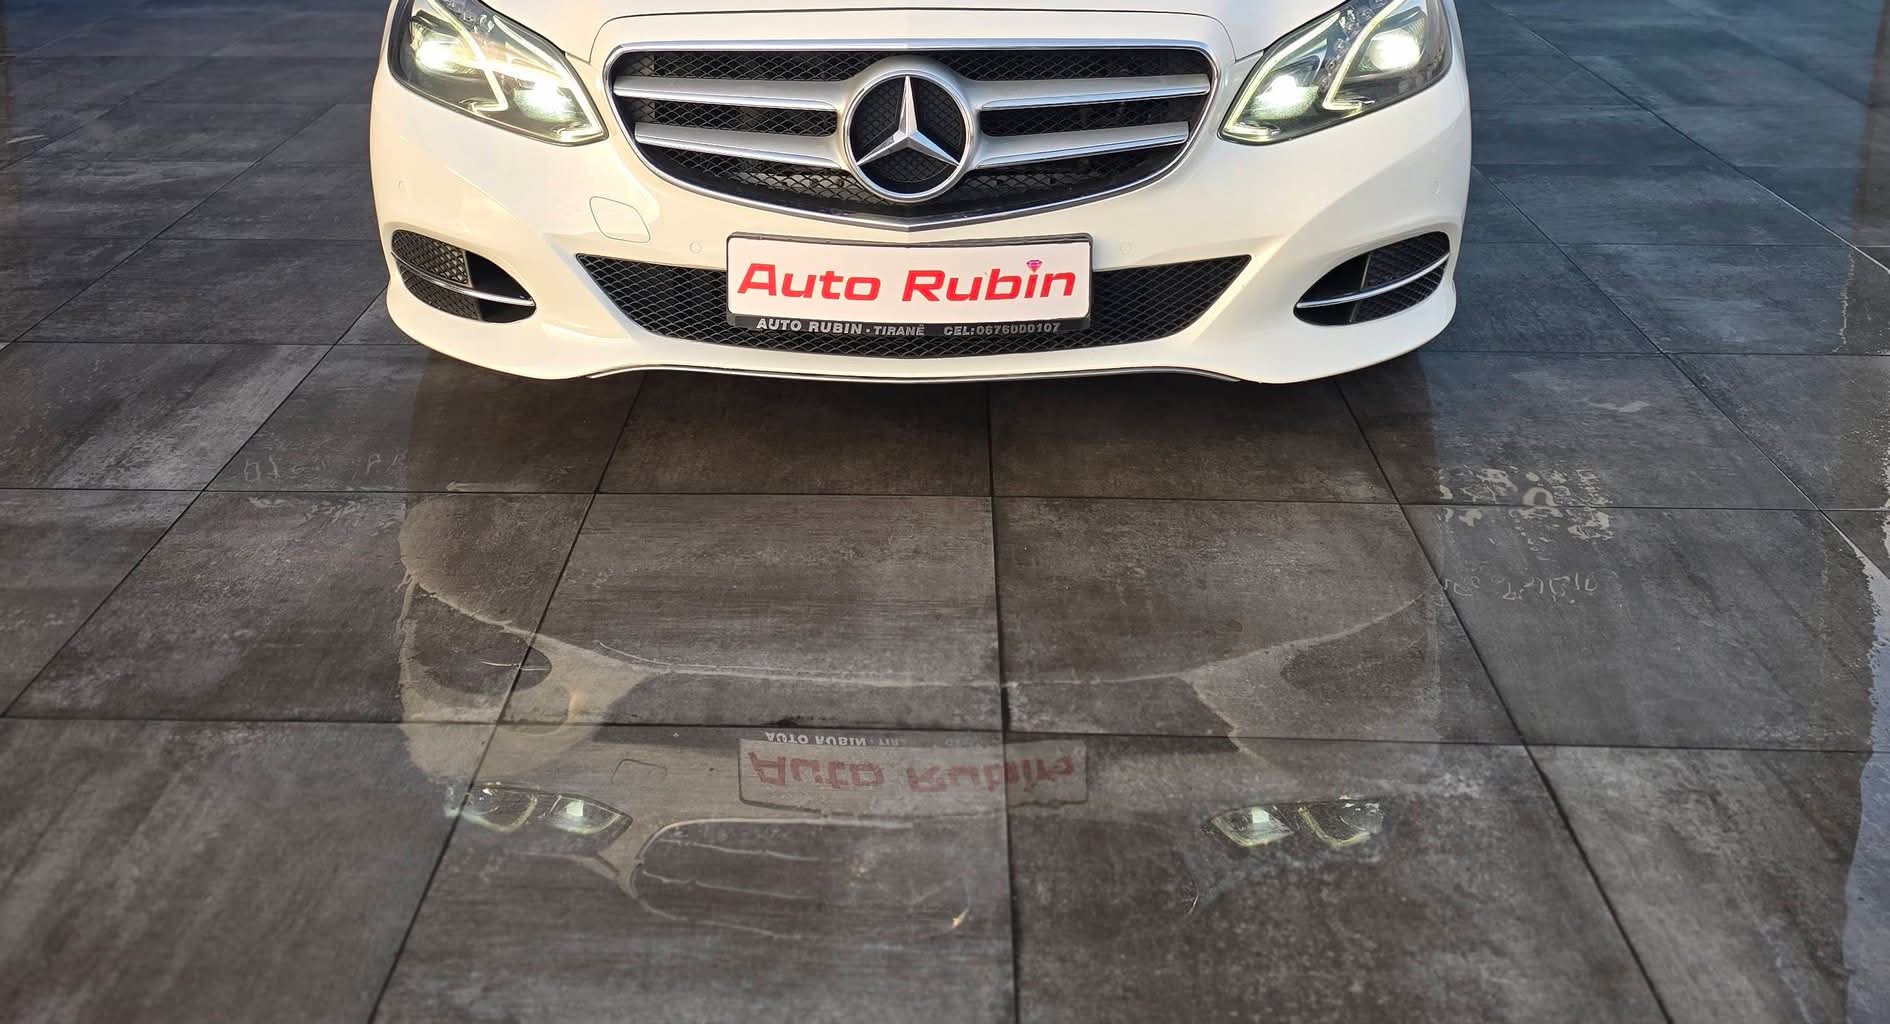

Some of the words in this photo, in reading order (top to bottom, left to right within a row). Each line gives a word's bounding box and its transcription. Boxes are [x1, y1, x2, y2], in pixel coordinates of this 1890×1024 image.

[737, 262, 882, 302] Auto
[901, 259, 1077, 302] Rubin
[756, 318, 802, 332] AUTO
[808, 321, 864, 335] RUBIN
[873, 324, 926, 337] TIRANË
